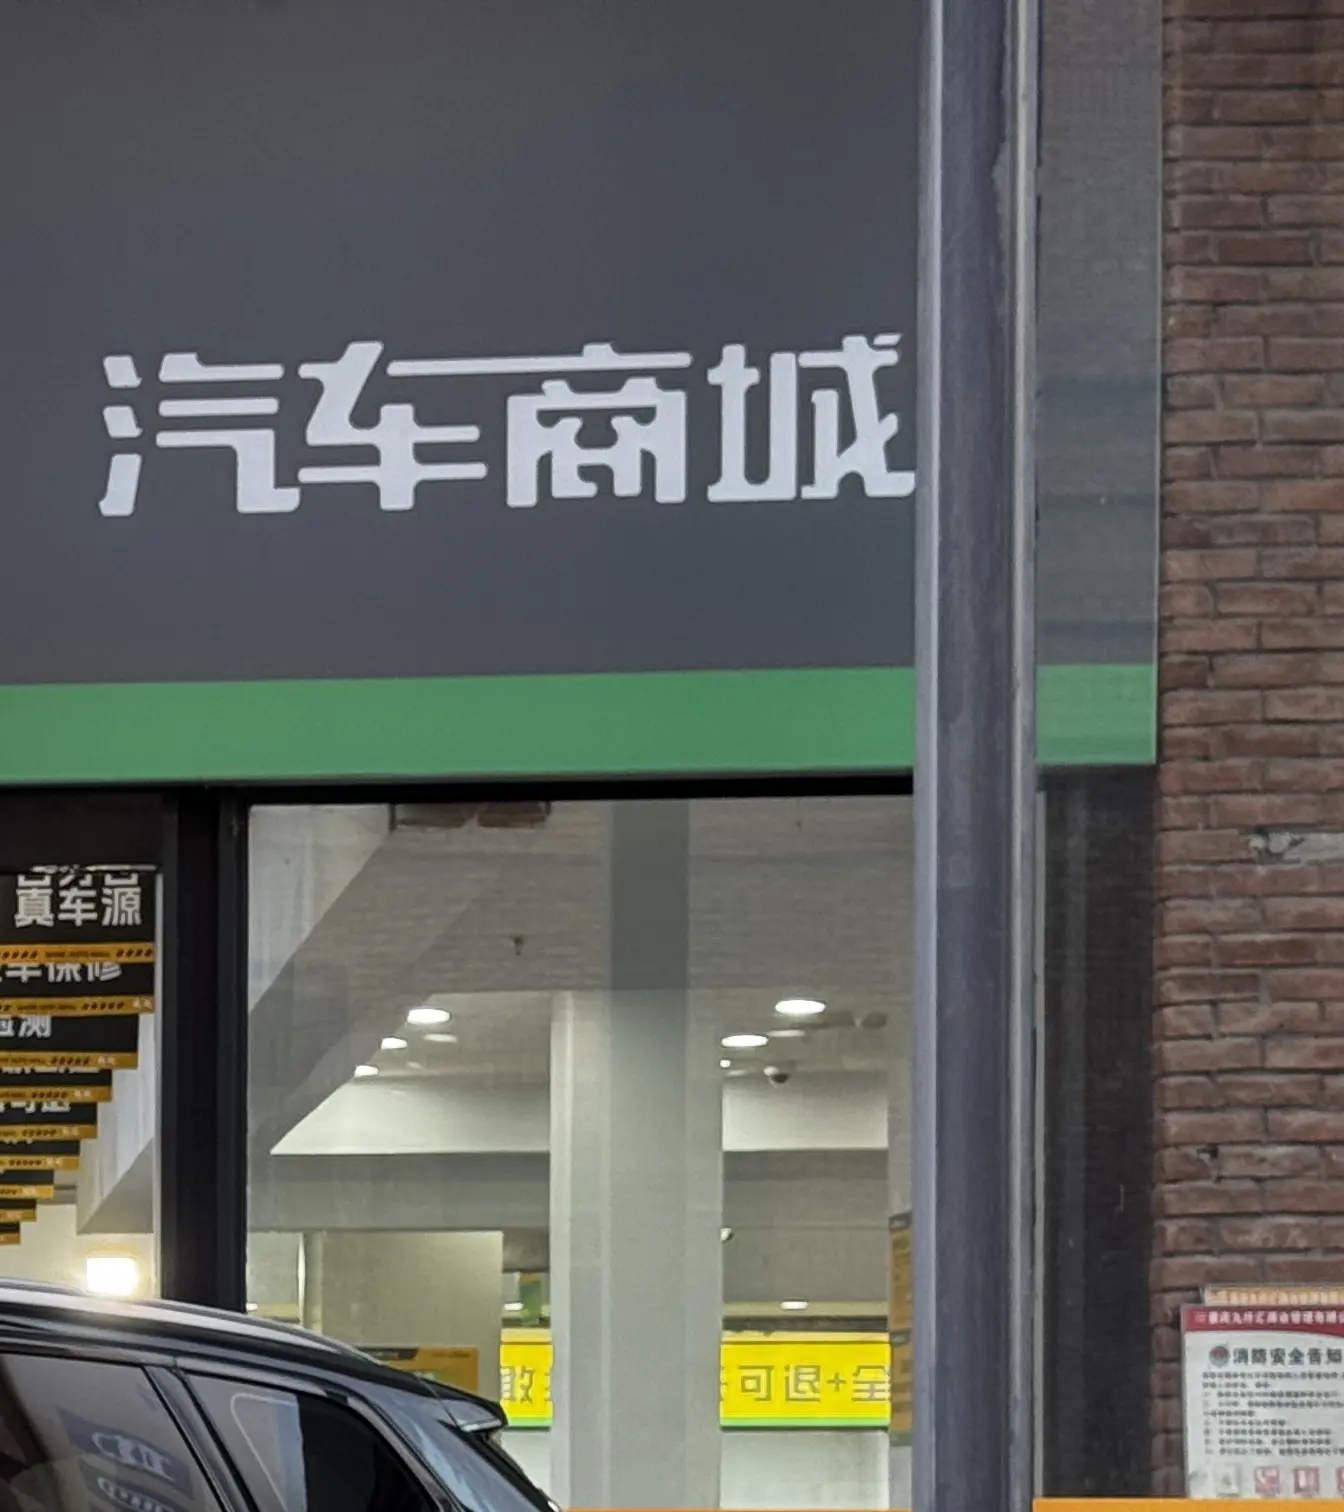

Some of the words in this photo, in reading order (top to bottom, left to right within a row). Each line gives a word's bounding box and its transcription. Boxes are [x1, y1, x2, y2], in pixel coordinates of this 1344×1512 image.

[98, 334, 916, 516] 汽车商城
[14, 886, 142, 928] 真车源
[722, 1364, 890, 1402] 可退+全
